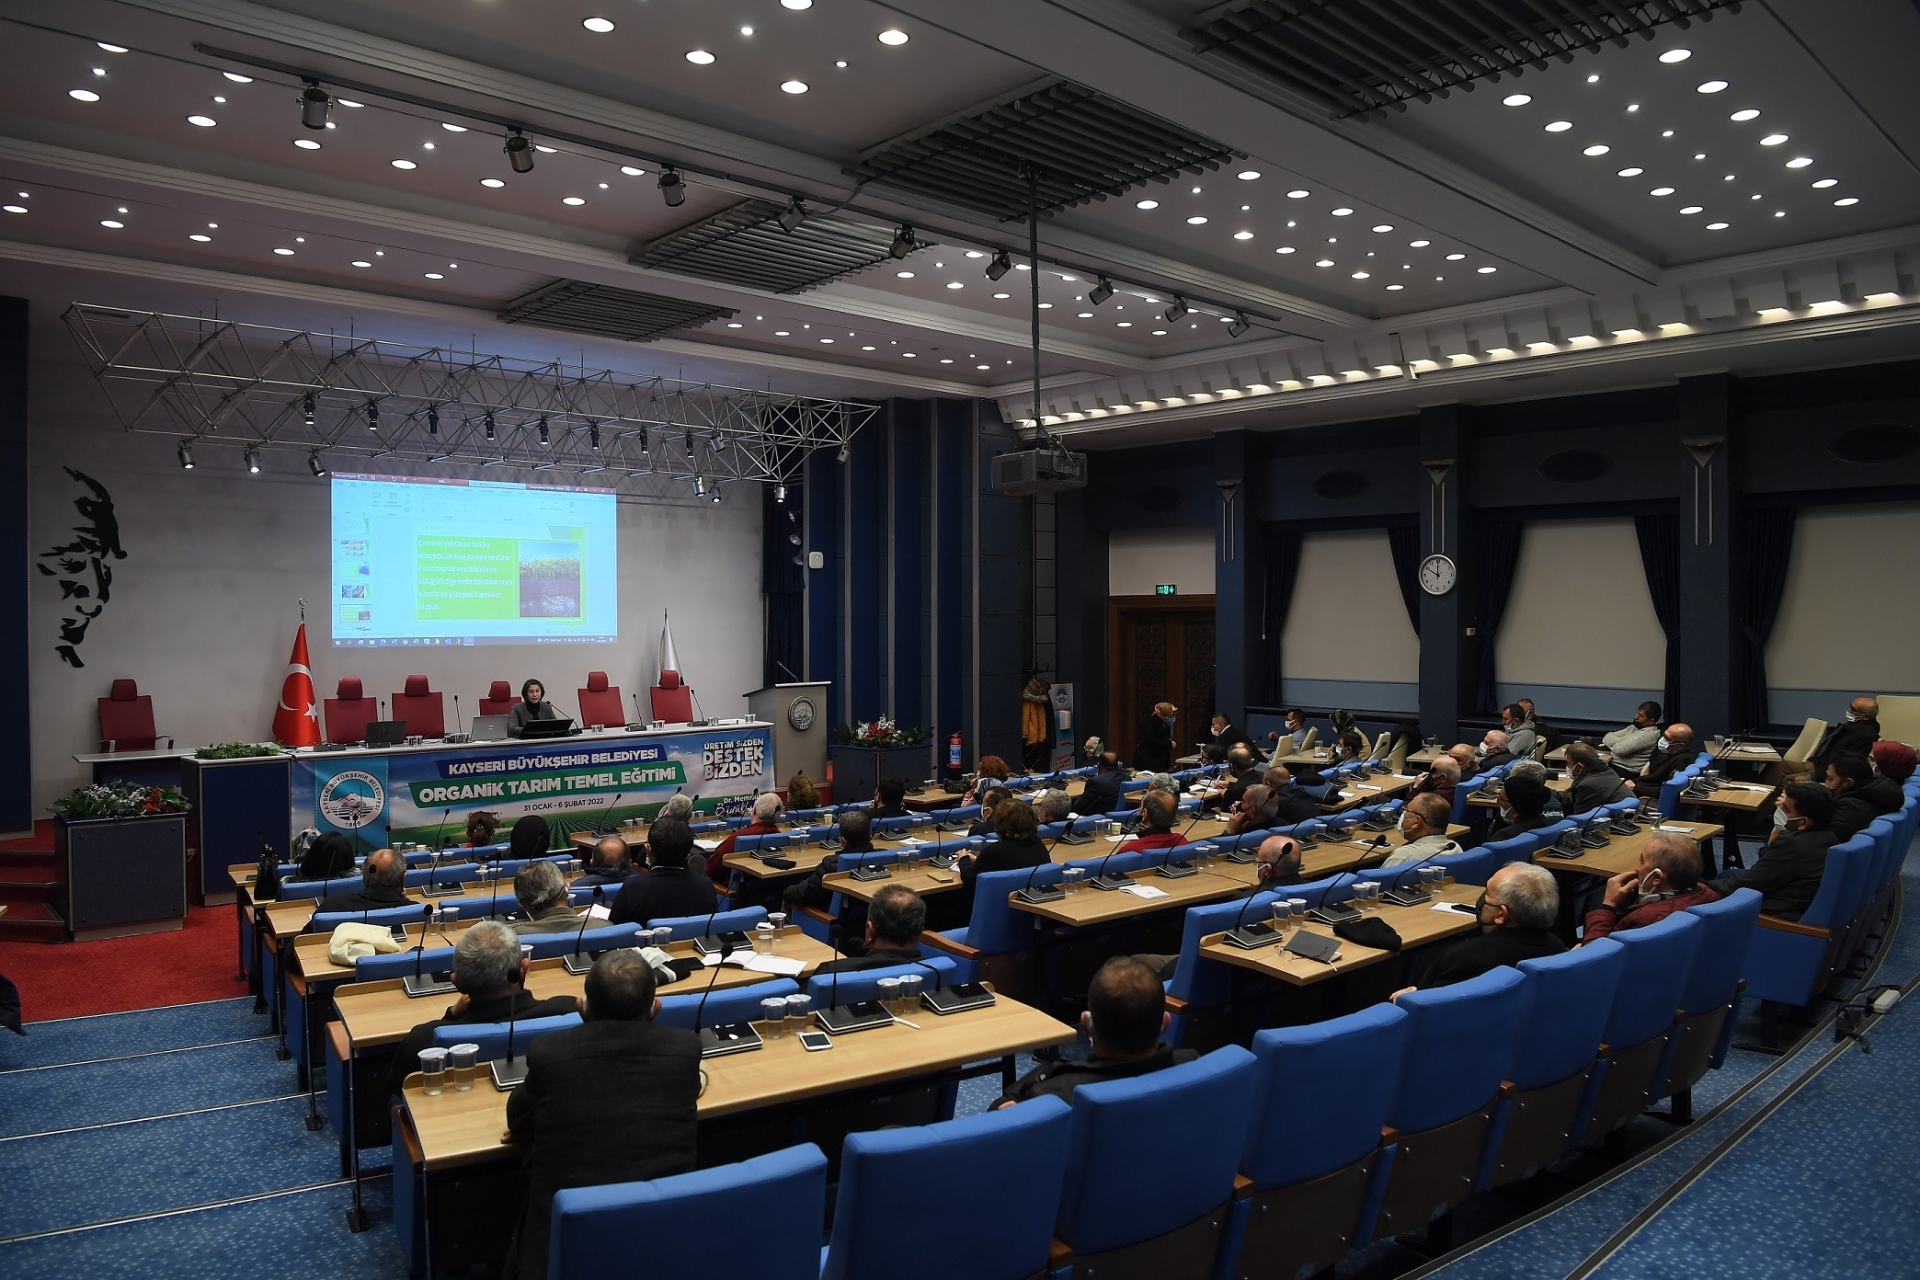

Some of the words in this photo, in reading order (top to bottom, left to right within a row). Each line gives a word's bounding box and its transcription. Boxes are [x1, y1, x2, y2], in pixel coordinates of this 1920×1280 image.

[703, 746, 764, 766] DESTEK
[508, 777, 561, 795] TARIM
[564, 773, 618, 790] TEMEL
[523, 804, 532, 812] 31
[564, 800, 586, 808] ŞUBAT
[588, 798, 604, 806] 2022
